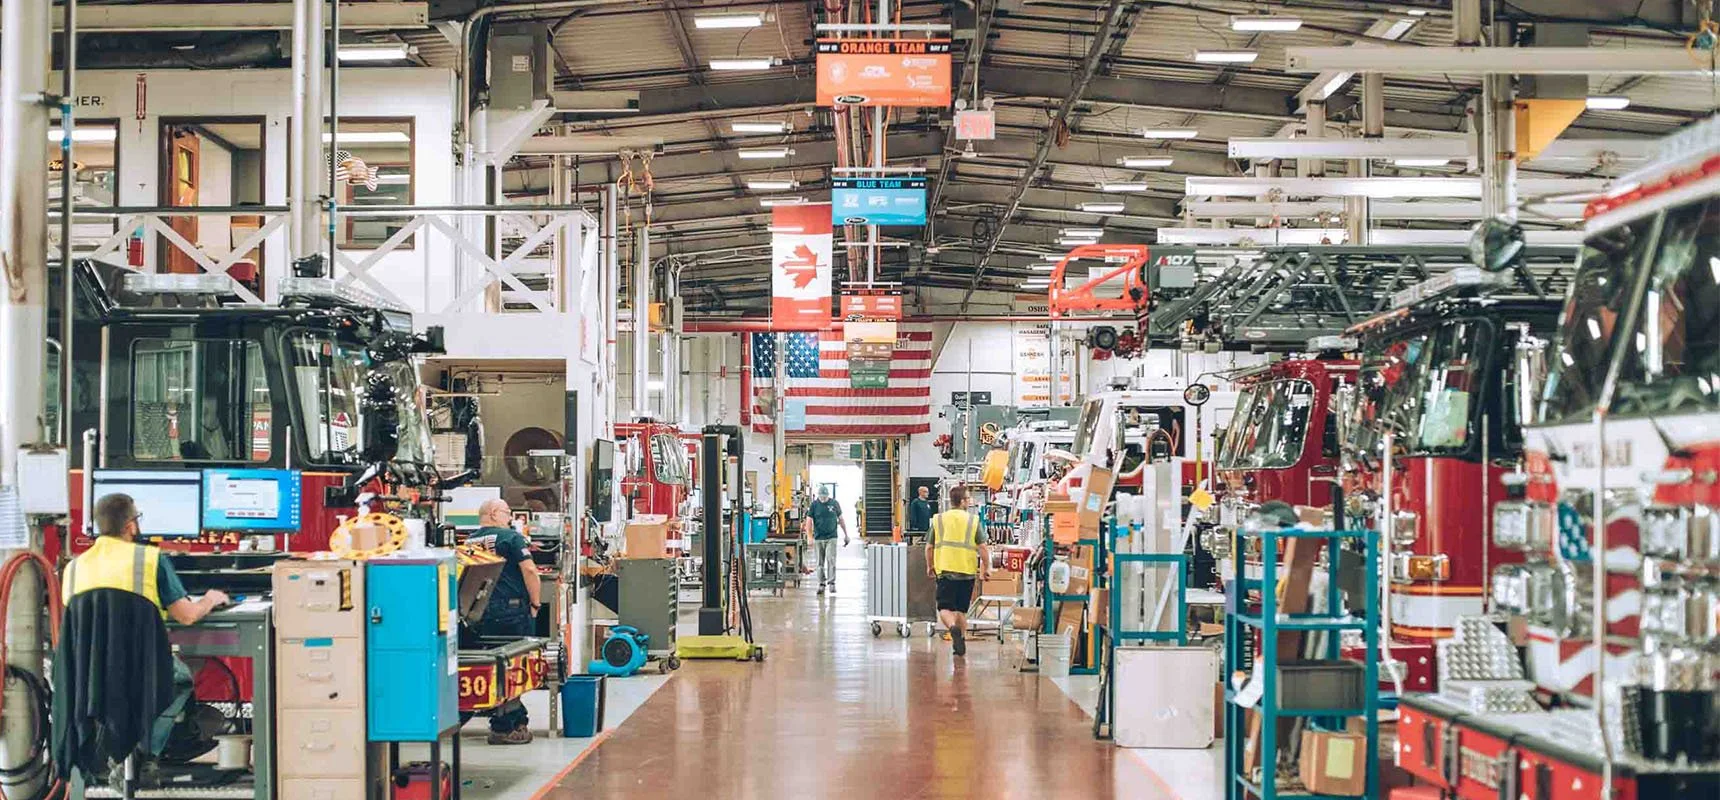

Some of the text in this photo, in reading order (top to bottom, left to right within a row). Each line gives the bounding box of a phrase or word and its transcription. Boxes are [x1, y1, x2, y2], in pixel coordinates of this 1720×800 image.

[841, 43, 926, 53] ORANGE TEAM
[1011, 558, 1022, 569] 81
[459, 675, 487, 697] 30
